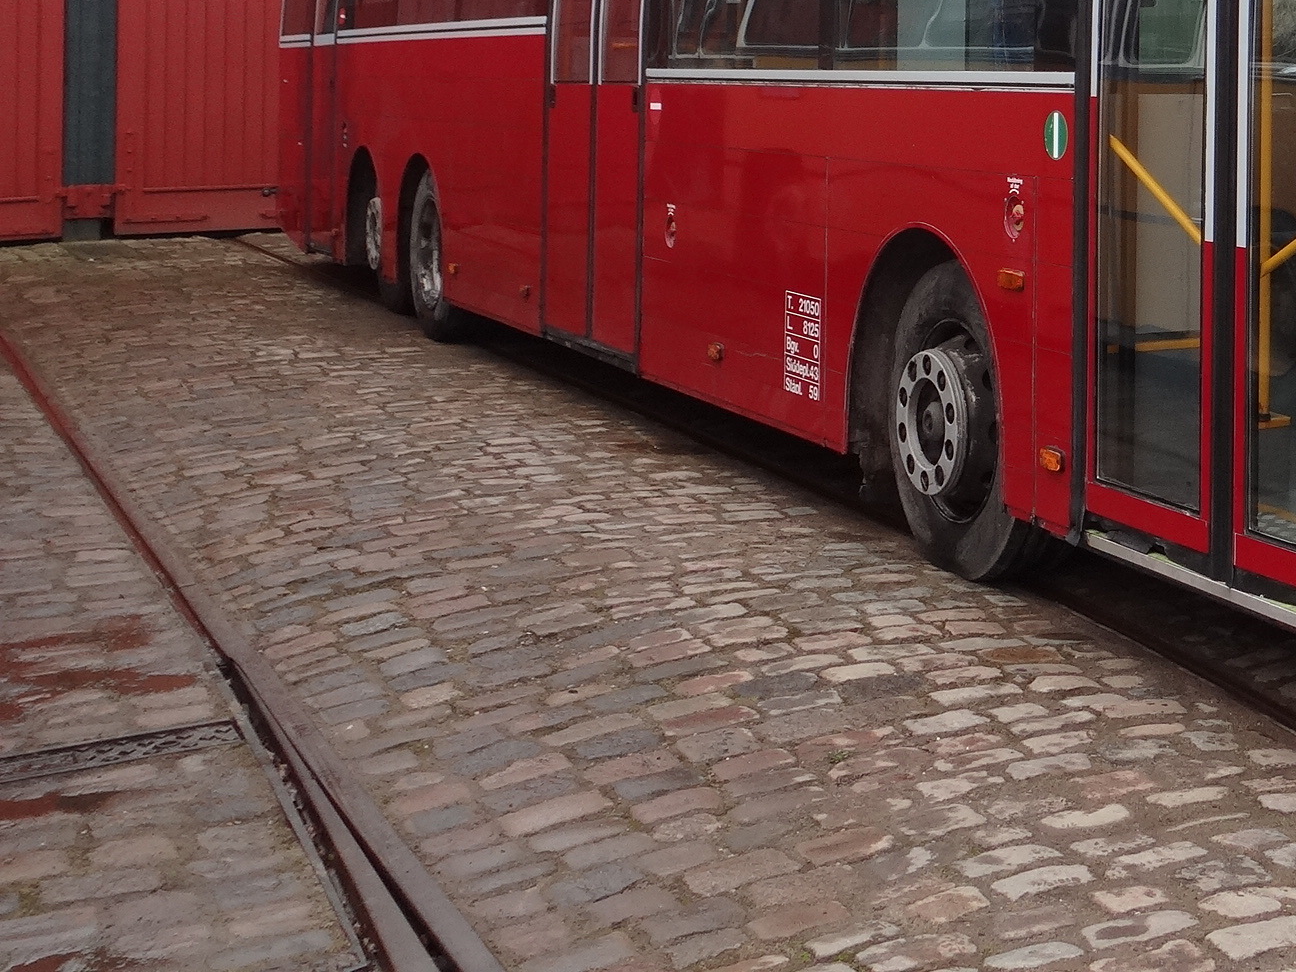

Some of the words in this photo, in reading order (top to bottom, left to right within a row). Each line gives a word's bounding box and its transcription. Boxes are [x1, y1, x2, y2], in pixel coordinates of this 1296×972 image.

[799, 298, 819, 316] 21050
[803, 320, 819, 337] 8125
[813, 344, 818, 358] 0
[809, 385, 818, 400] 59
